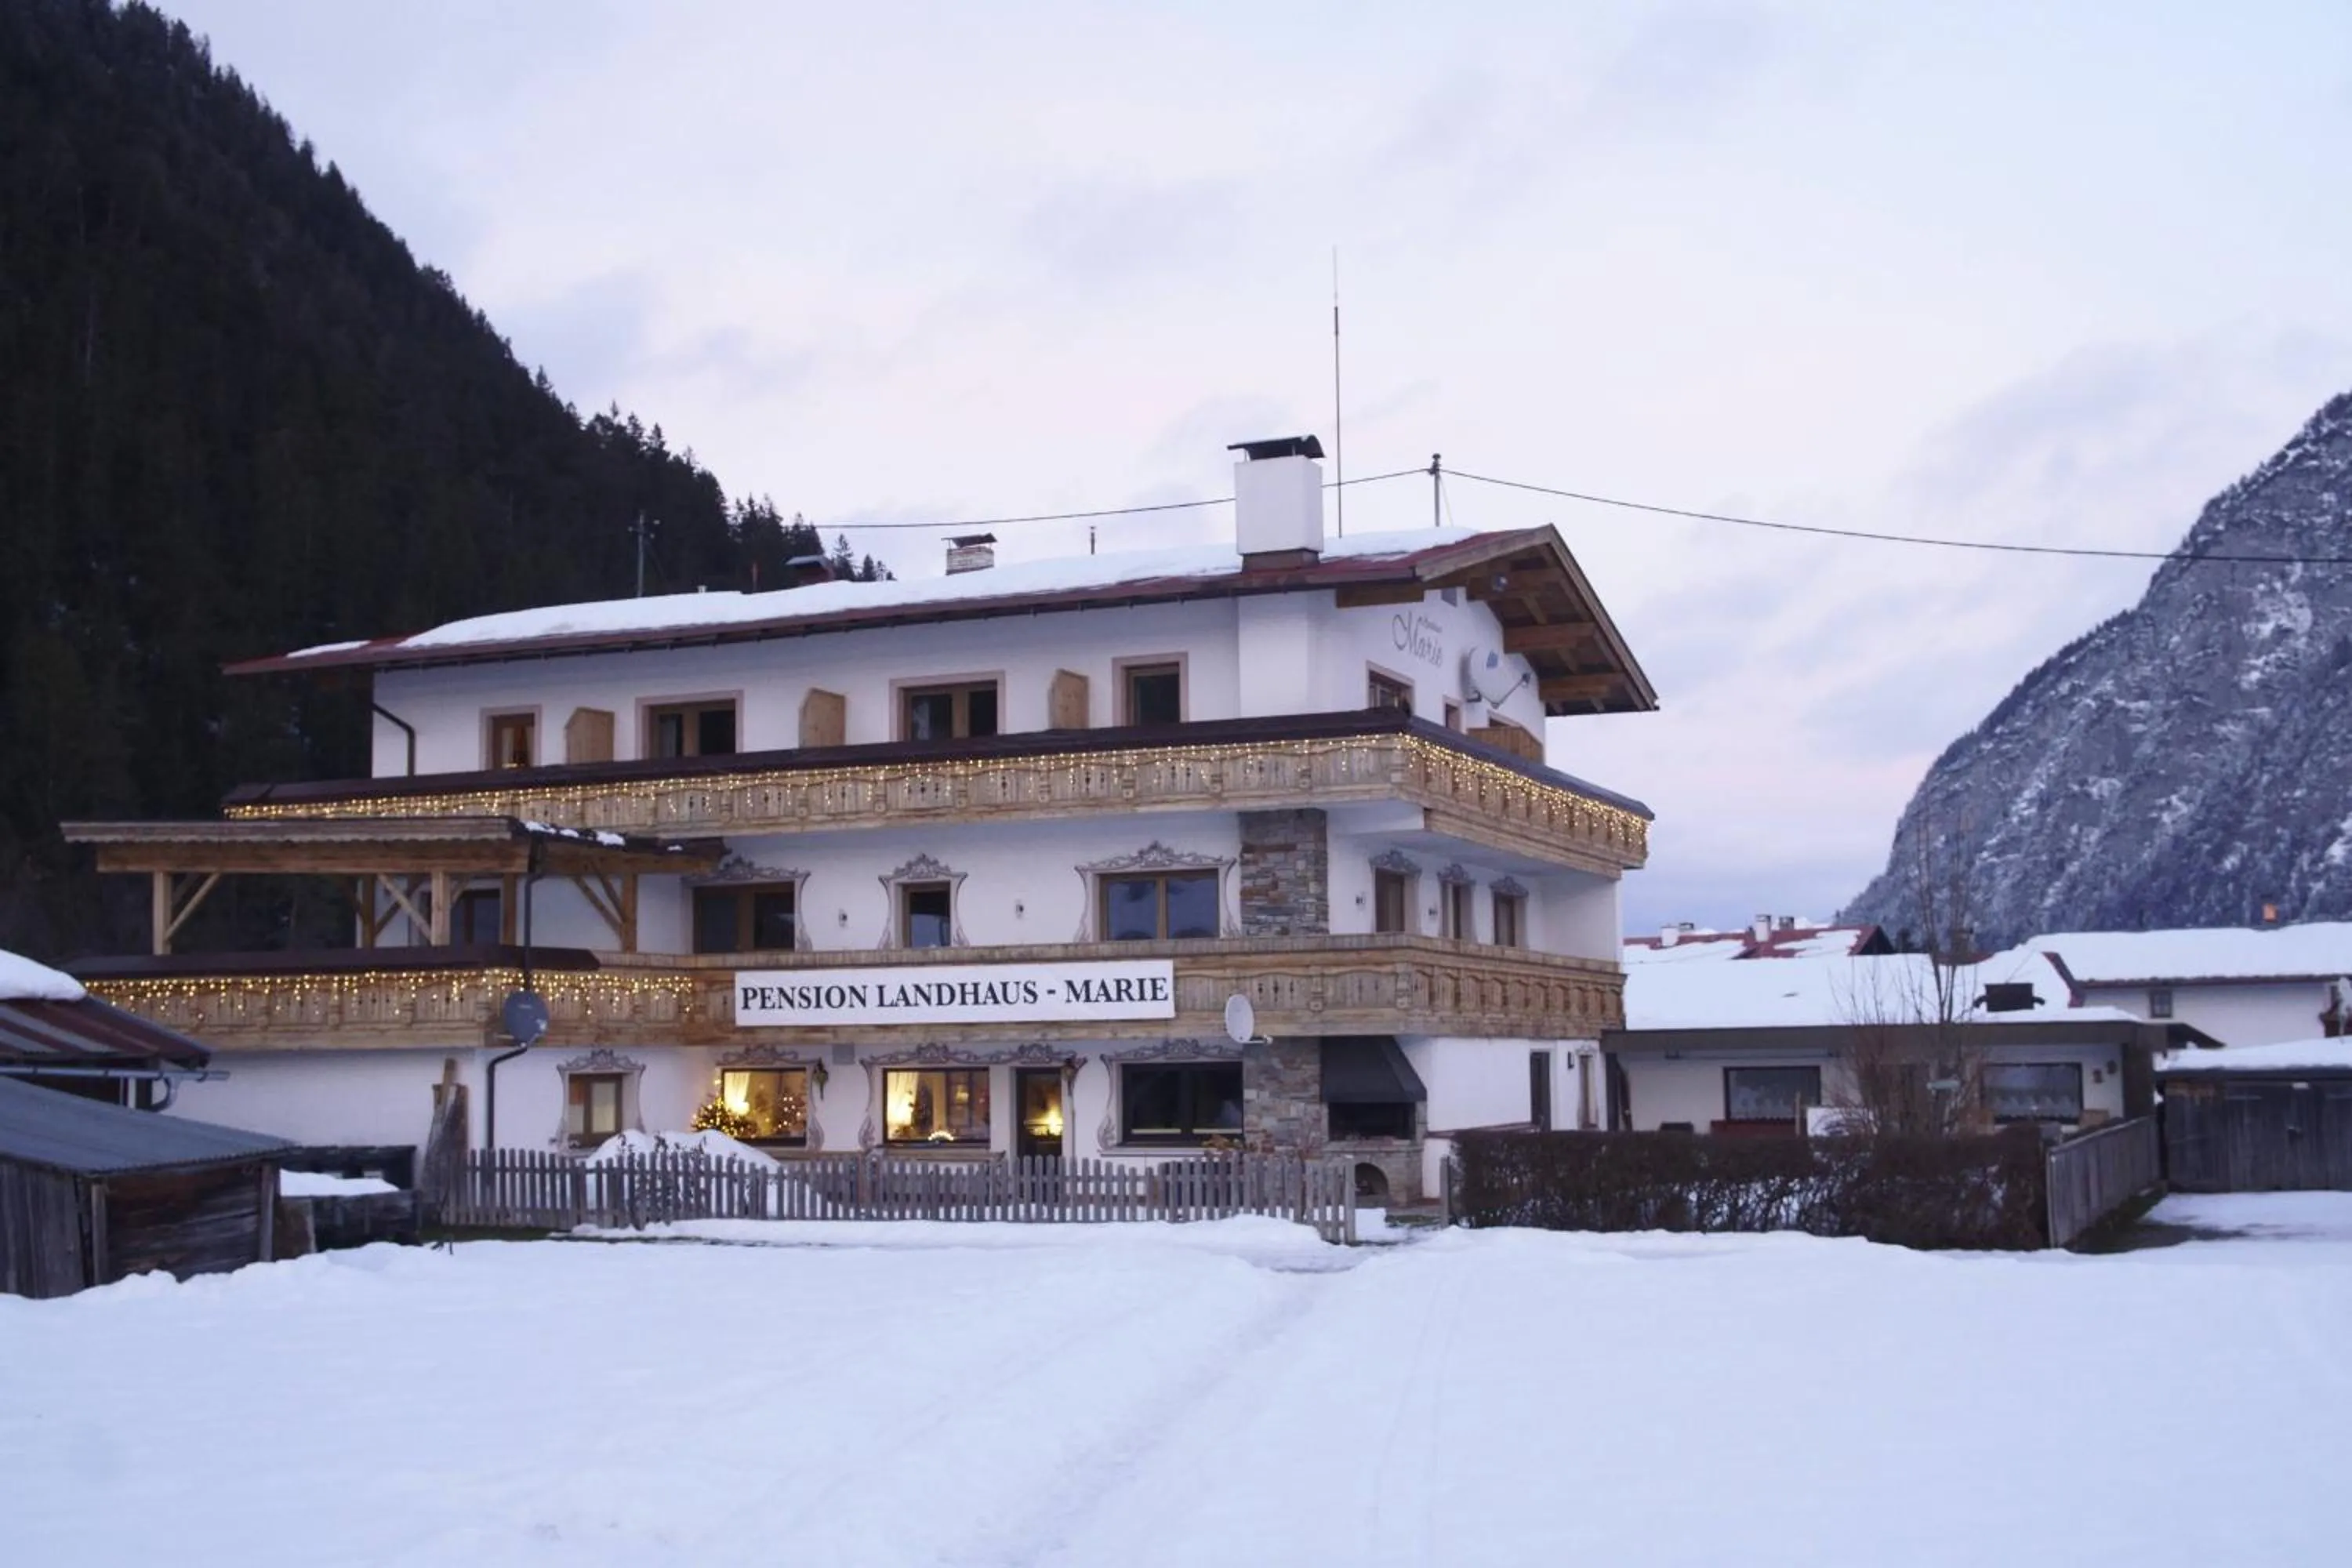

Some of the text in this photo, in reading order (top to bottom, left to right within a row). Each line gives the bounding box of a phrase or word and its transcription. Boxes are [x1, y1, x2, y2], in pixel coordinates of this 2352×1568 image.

[741, 985, 868, 1010] PENSION
[876, 980, 1039, 1007] LANDHAUS
[1064, 977, 1169, 1004] MARIE
